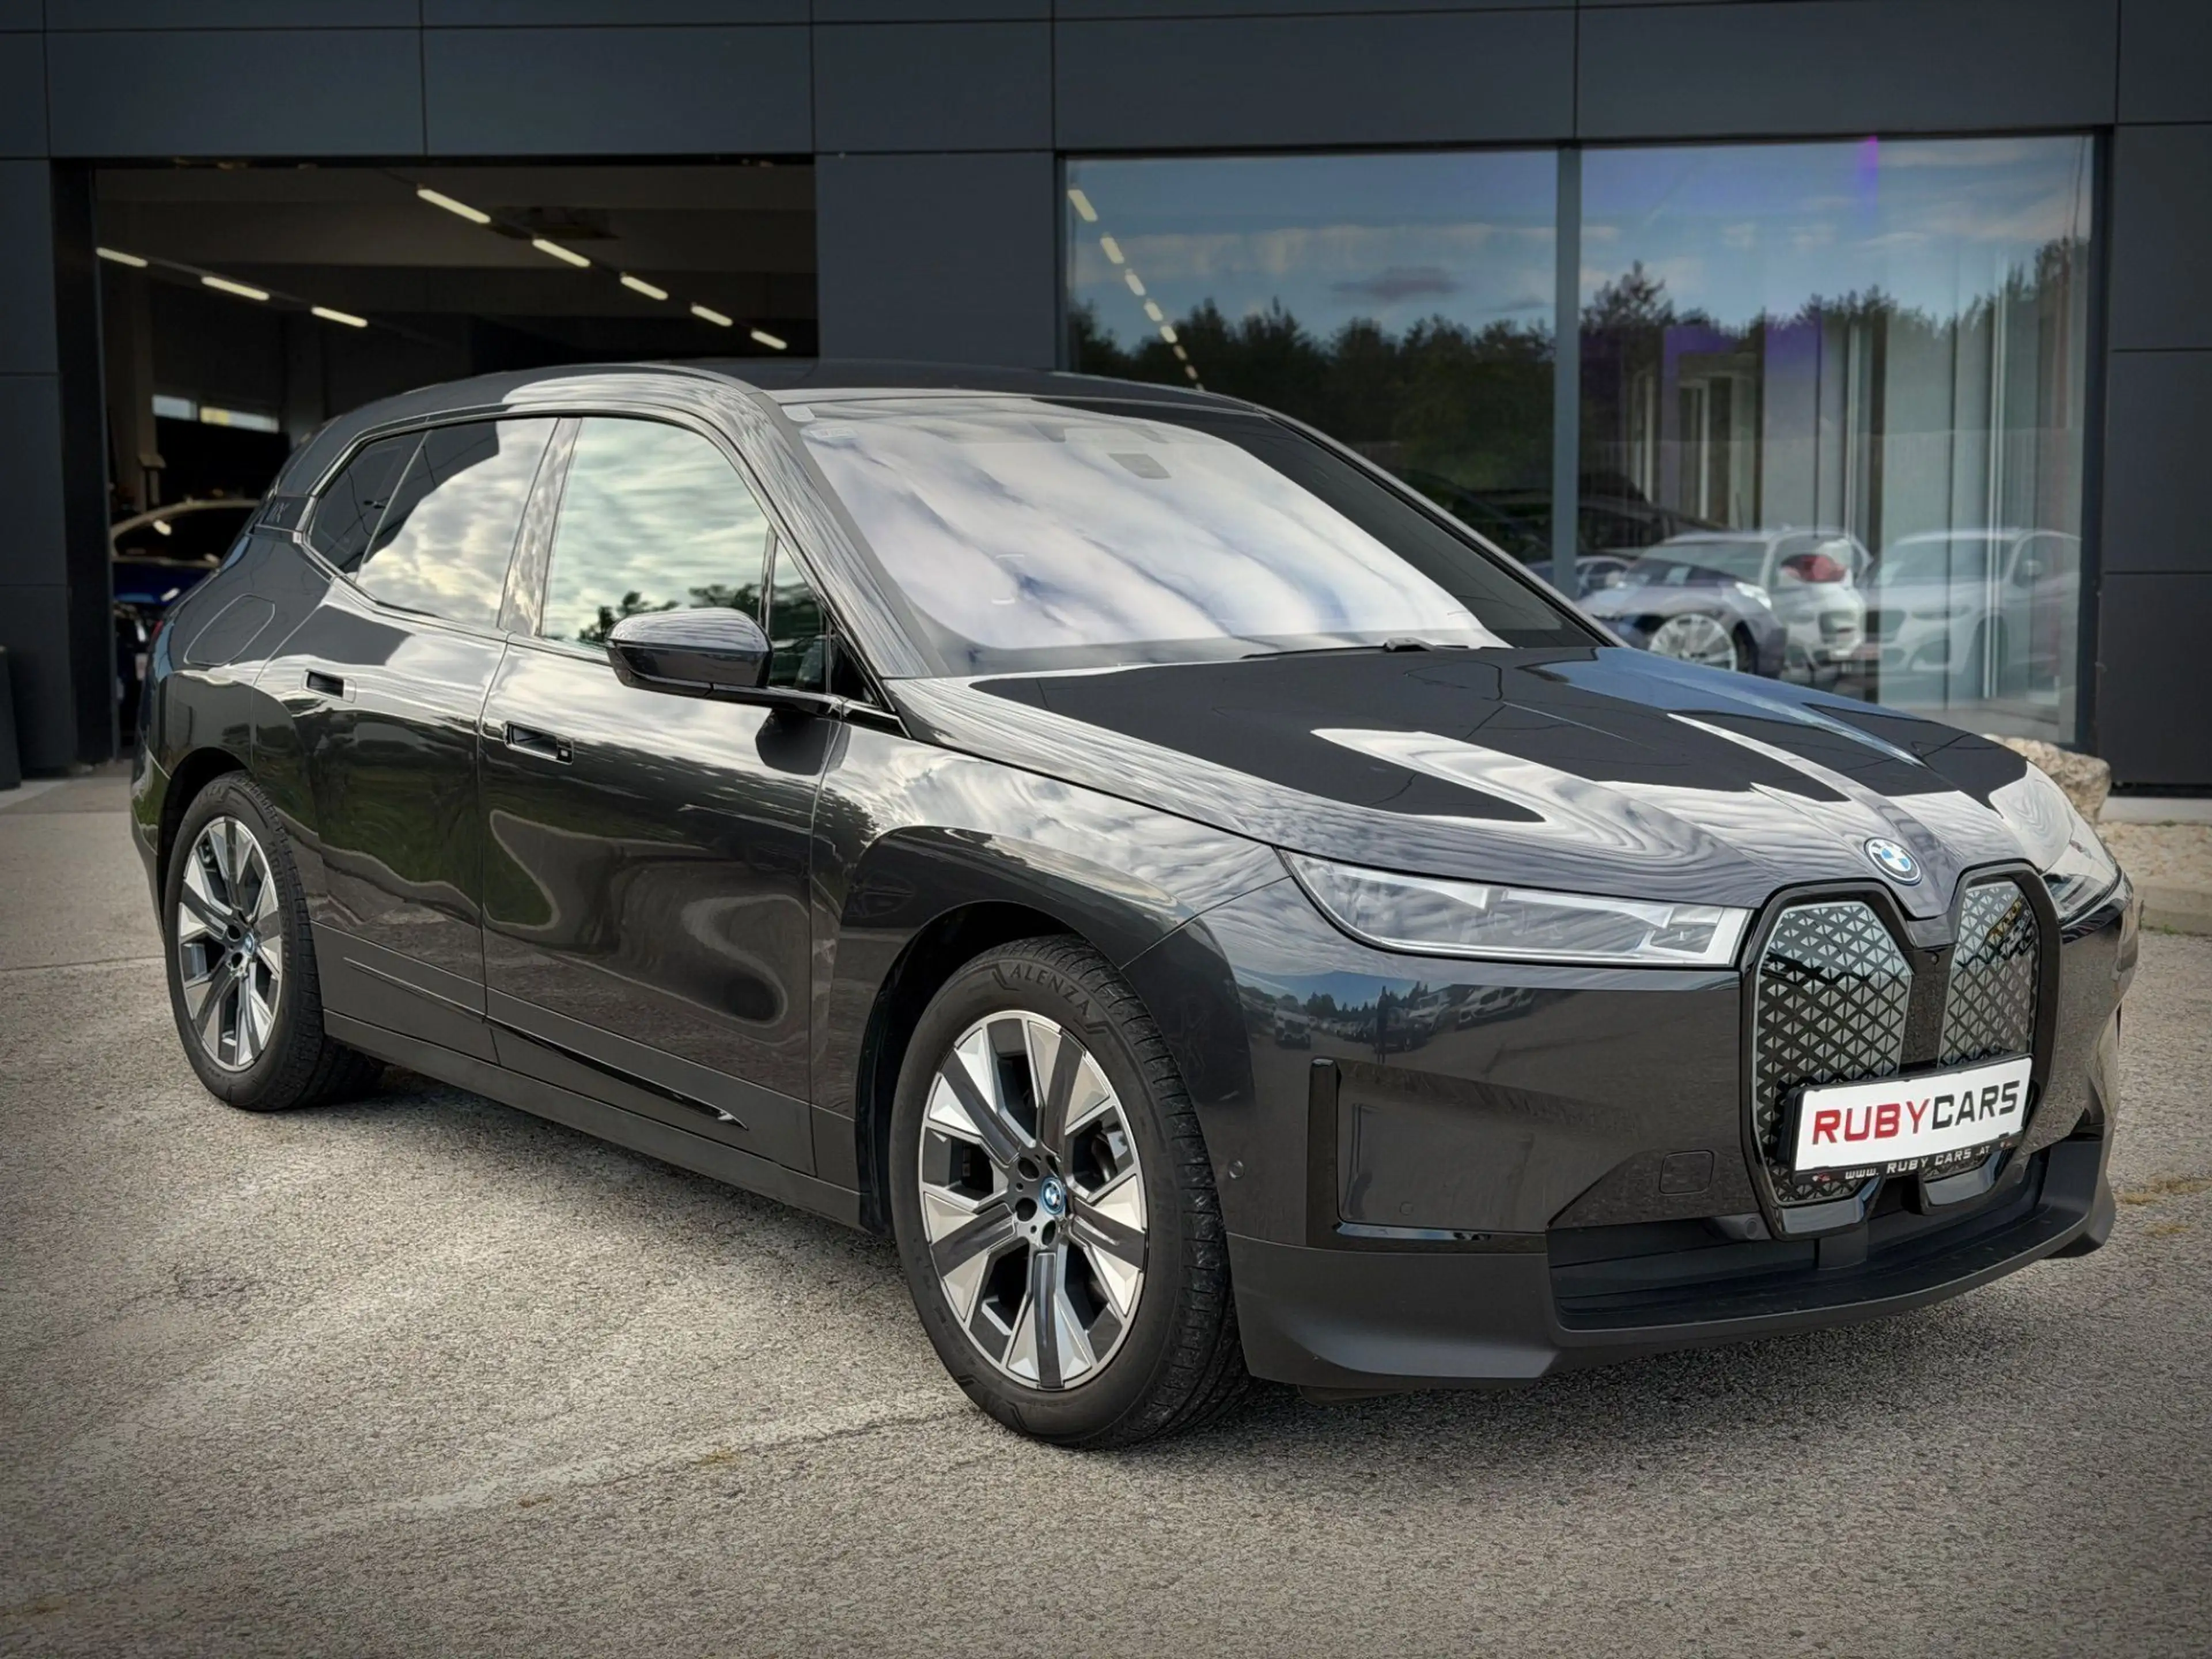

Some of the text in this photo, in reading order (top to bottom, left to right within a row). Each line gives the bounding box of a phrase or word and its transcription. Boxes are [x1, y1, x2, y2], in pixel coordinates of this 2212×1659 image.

[1010, 964, 1090, 1016] ALENZA
[1812, 1080, 2020, 1145] RUBYCARS
[1887, 1157, 1929, 1174] RUBY
[1934, 1148, 1972, 1166] CARS
